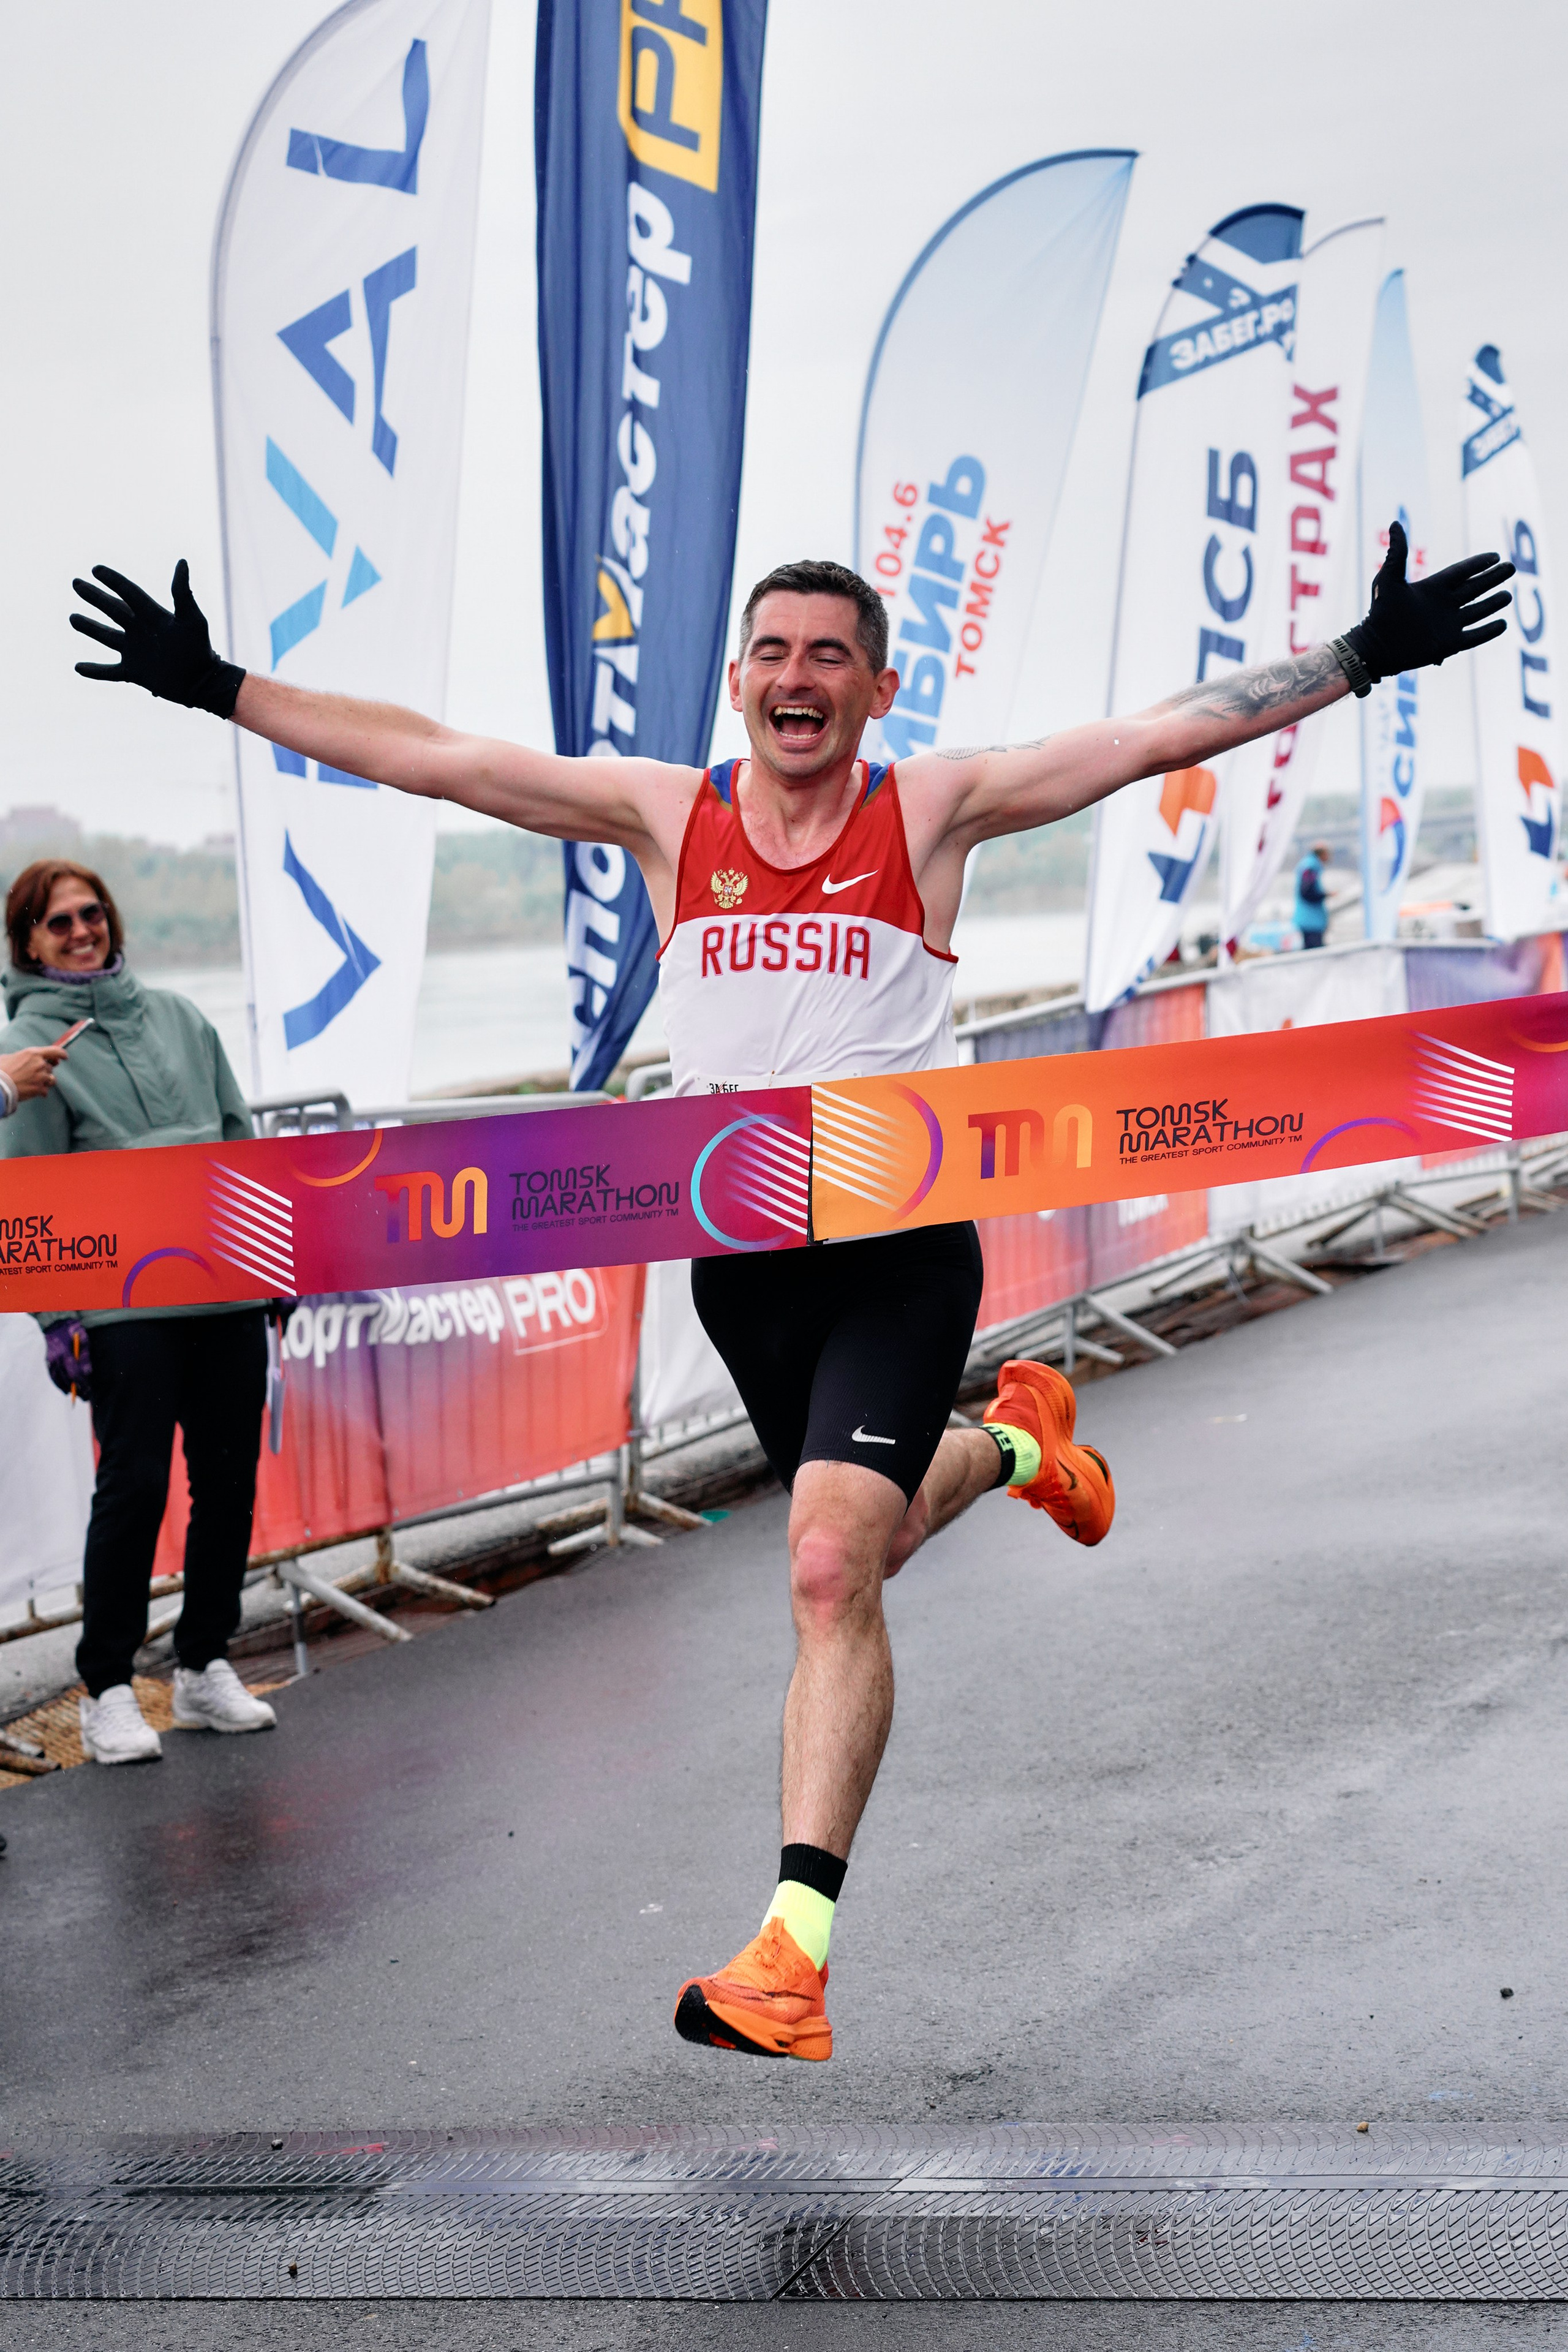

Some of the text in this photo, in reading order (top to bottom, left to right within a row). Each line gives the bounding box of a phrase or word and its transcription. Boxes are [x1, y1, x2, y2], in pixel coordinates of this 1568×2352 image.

[881, 455, 986, 761] ИБИРЬ
[955, 516, 1012, 678] ТОМСК
[701, 921, 871, 981] RUSSIA
[1117, 1098, 1228, 1131] TOMSK
[1120, 1112, 1303, 1154] MARATHON
[1120, 1156, 1138, 1164] THE
[1140, 1150, 1189, 1162] GREATEST
[1192, 1145, 1224, 1156] SPORT
[1227, 1137, 1286, 1151] COMMUNITY
[509, 1164, 611, 1194] TOMSK
[512, 1182, 679, 1220] MARATHON
[0, 1215, 53, 1240] MSK
[532, 1218, 576, 1230] GREATEST
[578, 1215, 608, 1225] SPORT
[610, 1210, 663, 1223] COMMUNITY
[0, 1234, 117, 1264] RATHON
[0, 1267, 23, 1276] ATEST
[25, 1265, 52, 1274] SPORT
[54, 1261, 104, 1272] COMMUNITY
[282, 1268, 596, 1368] ортМастер PRO
